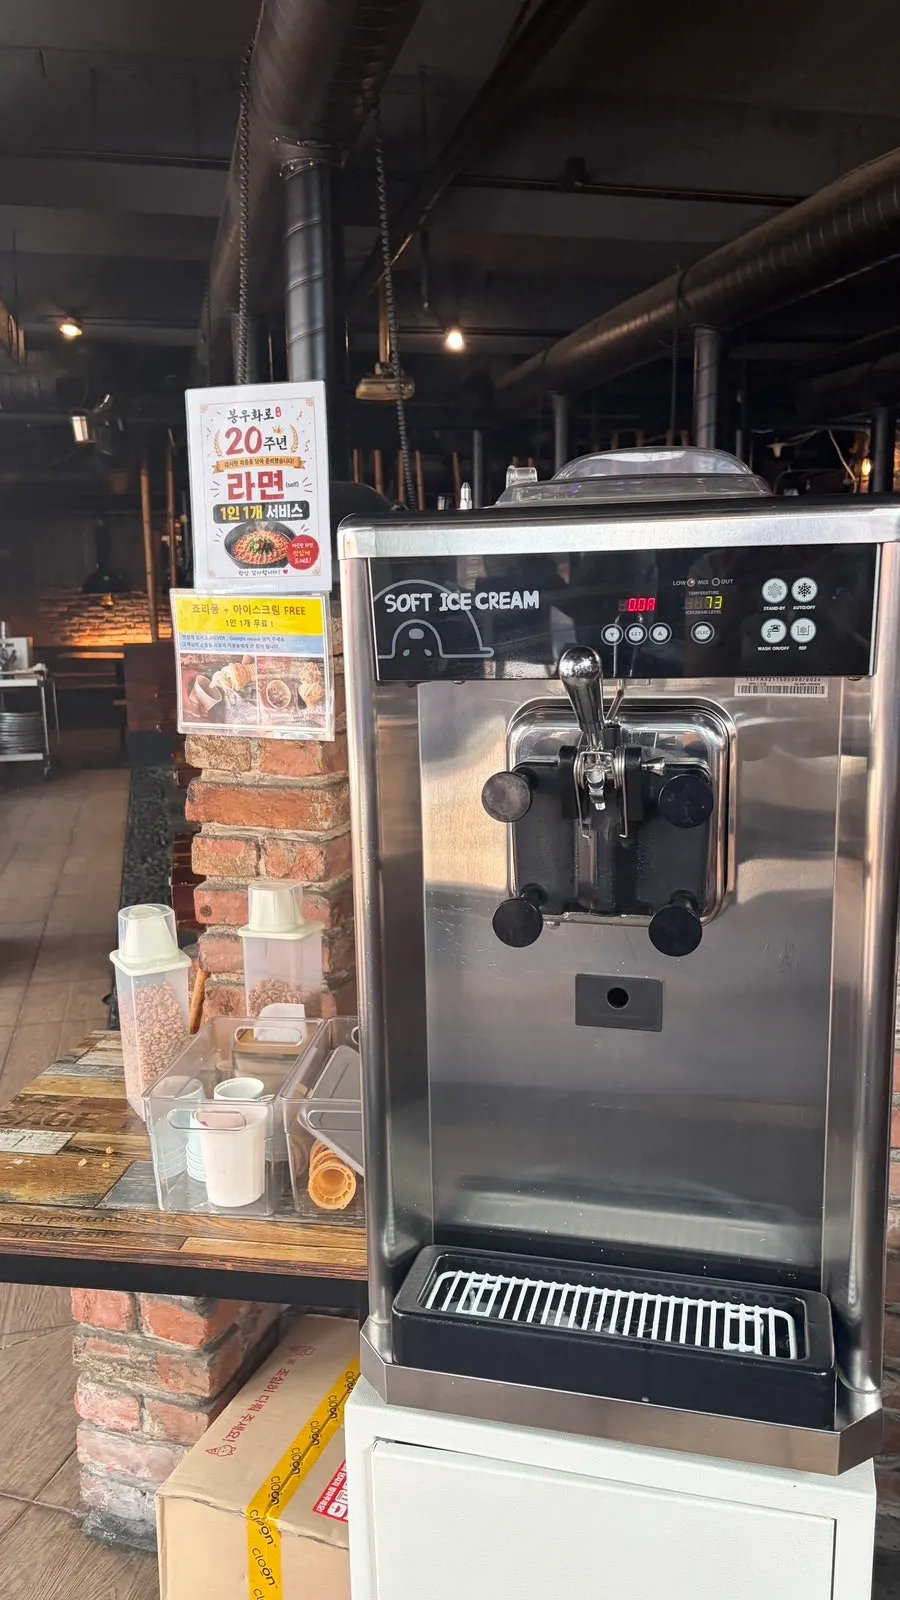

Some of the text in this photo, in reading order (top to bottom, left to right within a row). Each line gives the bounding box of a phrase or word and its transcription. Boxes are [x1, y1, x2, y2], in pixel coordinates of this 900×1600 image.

[227, 408, 275, 424] 봉우화로
[227, 470, 284, 501] 라면
[220, 503, 304, 520] 1인 1개 서비스
[384, 590, 540, 613] SOFT ICE CREAM
[706, 595, 723, 610] 73
[233, 604, 280, 616] 아이스크림
[284, 606, 306, 616] FREE
[225, 619, 237, 628] 1인
[240, 619, 251, 628] 1개
[253, 619, 269, 629] 무료
[222, 1413, 255, 1443] 주세요!
